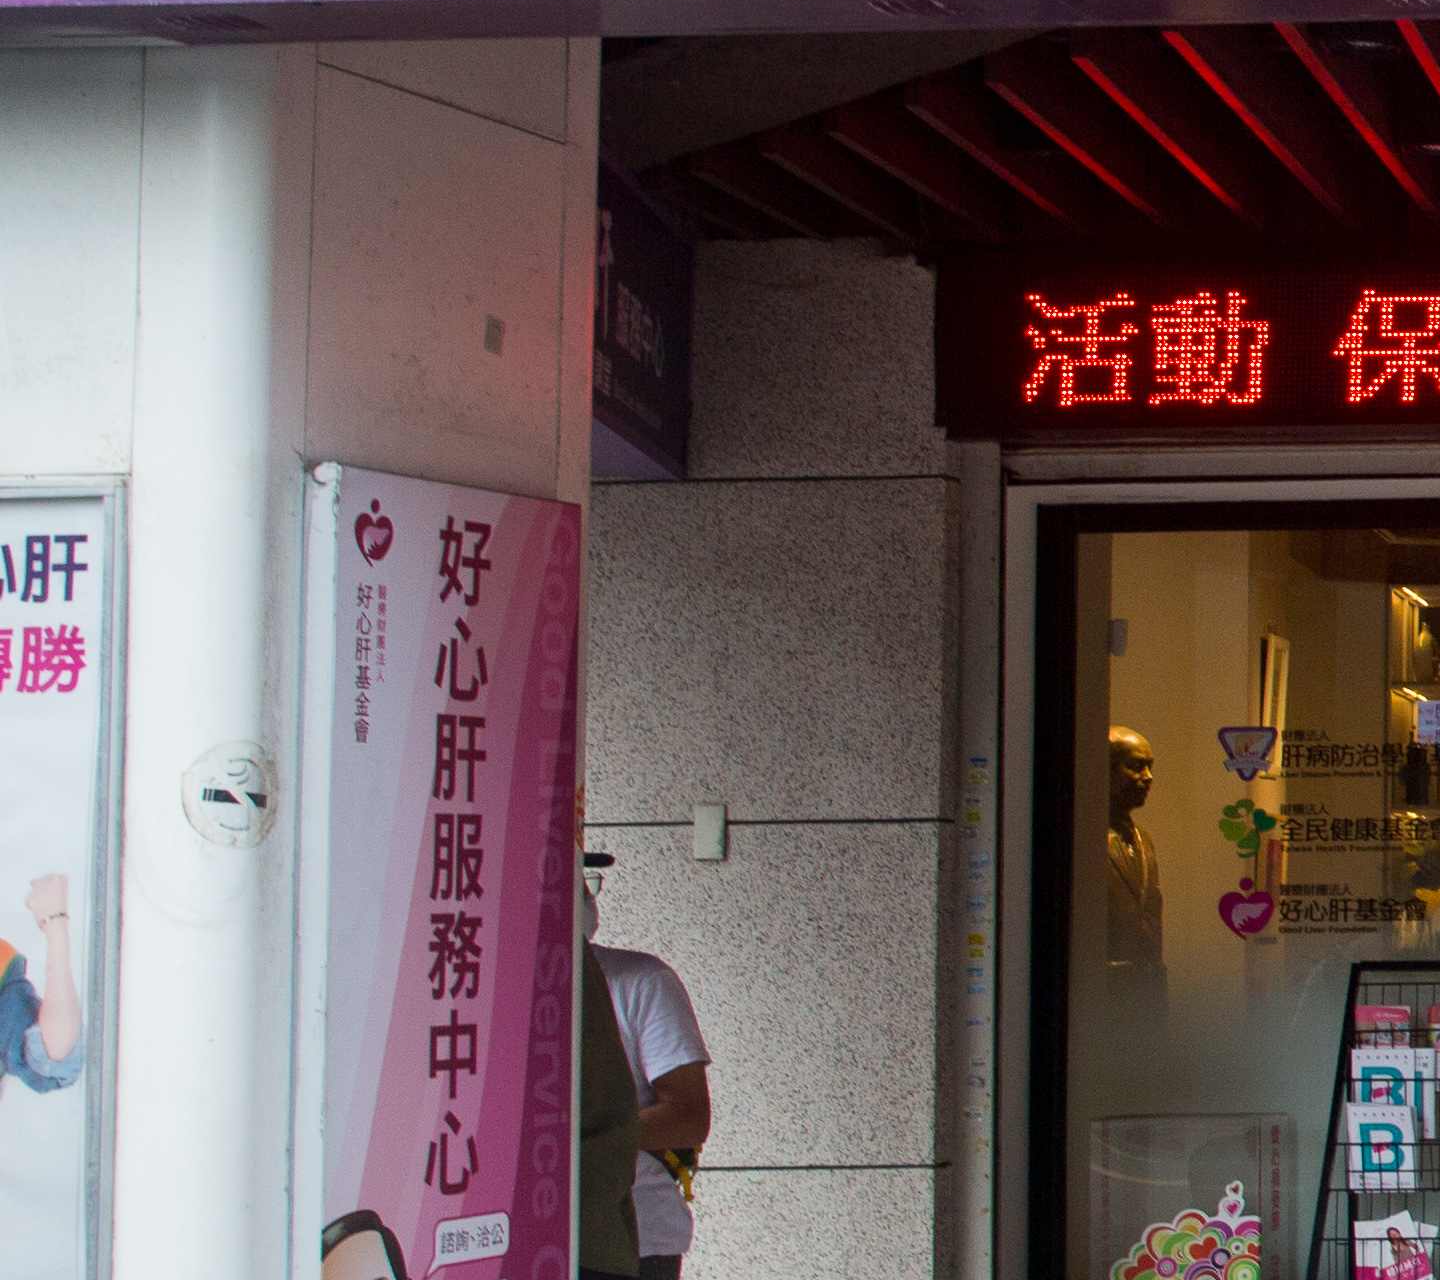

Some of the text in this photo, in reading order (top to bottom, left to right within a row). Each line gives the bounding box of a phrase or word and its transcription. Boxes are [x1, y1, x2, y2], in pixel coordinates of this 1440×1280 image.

[1024, 290, 1270, 408] 活動
[0, 534, 88, 602] 肝
[0, 624, 87, 692] 勝
[354, 581, 373, 744] 好心肝基金會
[424, 515, 491, 1196] 好心肝服務中心
[1280, 898, 1427, 922] 好心肝基金會
[1360, 1123, 1405, 1172] B
